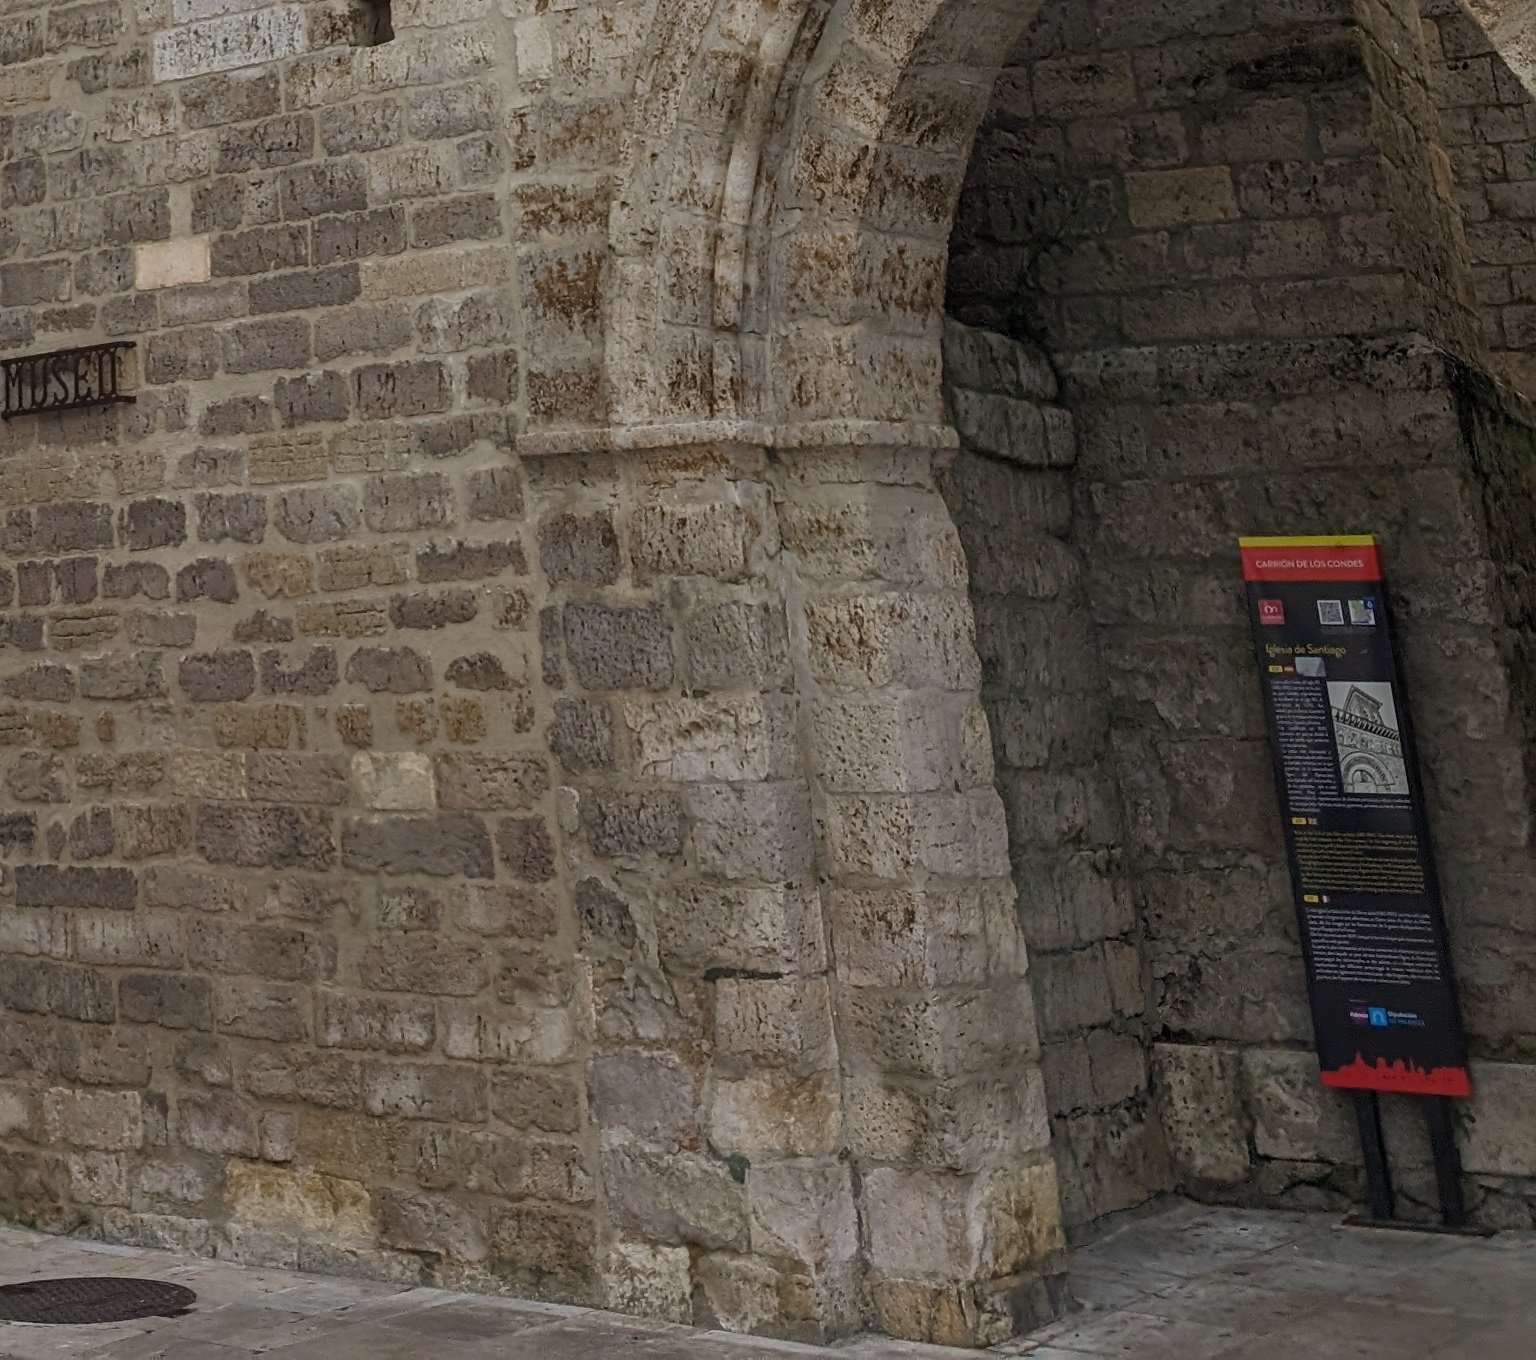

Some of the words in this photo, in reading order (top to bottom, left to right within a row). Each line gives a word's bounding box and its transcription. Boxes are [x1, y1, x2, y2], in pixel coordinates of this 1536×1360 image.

[4, 346, 118, 412] MUSEO
[1296, 559, 1308, 569] DE
[1309, 559, 1326, 569] LOS
[1327, 559, 1364, 569] CONDES
[1265, 643, 1293, 658] Iglesia
[1294, 644, 1305, 655] de
[1306, 643, 1347, 659] Santiago
